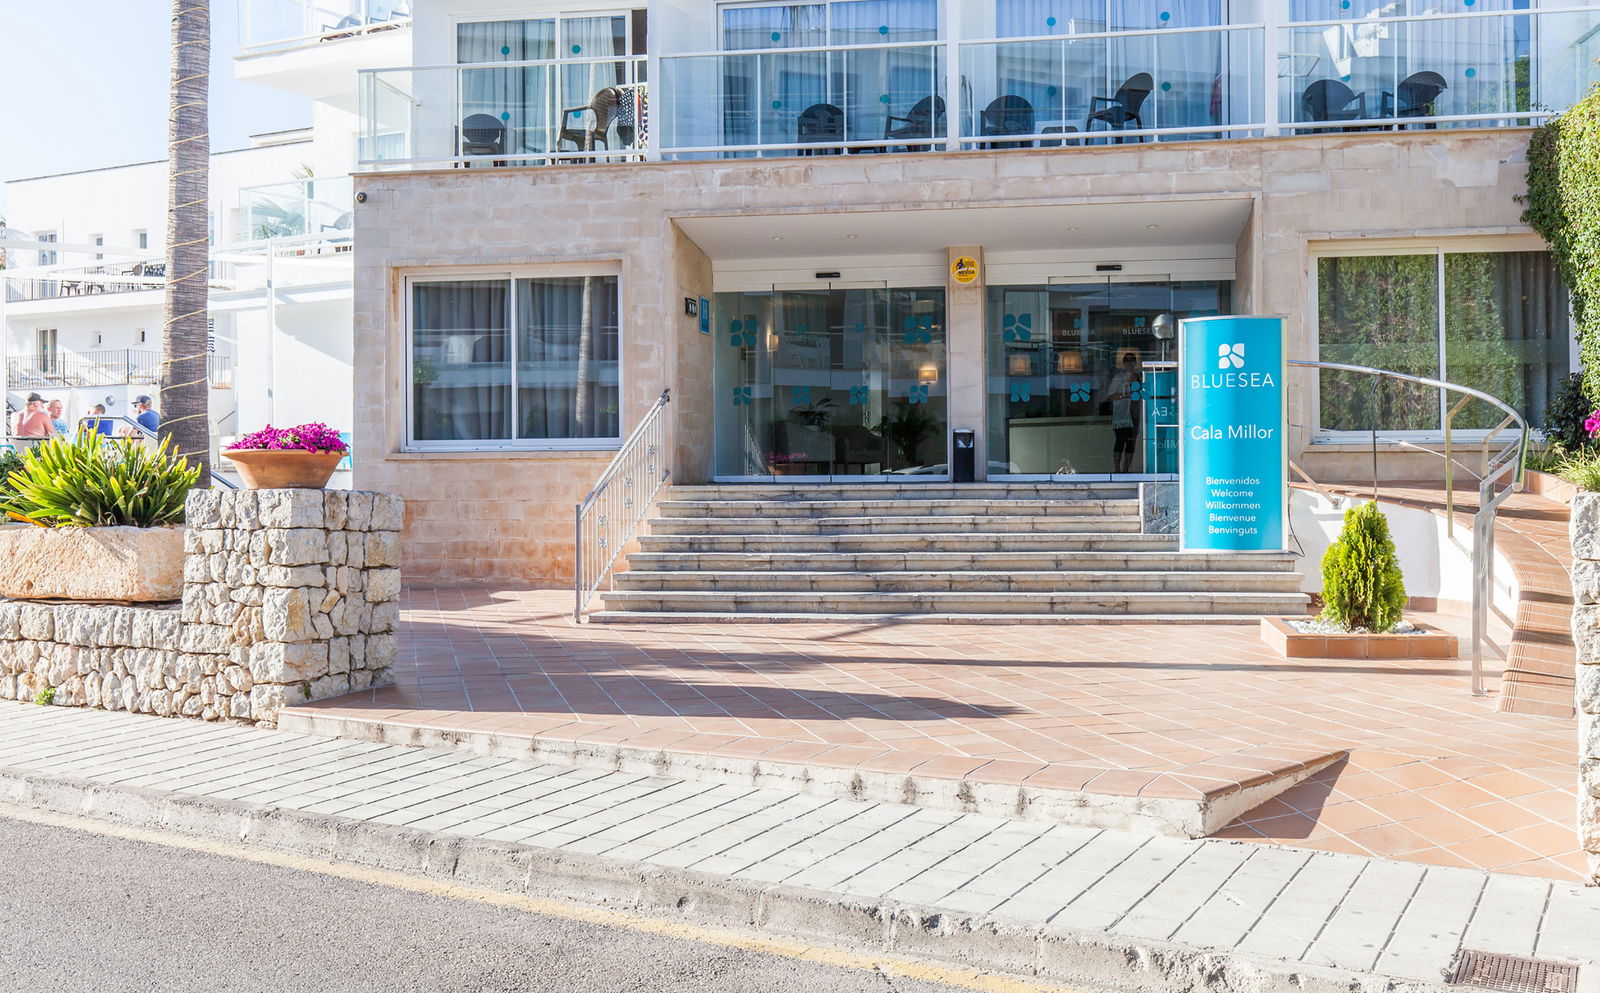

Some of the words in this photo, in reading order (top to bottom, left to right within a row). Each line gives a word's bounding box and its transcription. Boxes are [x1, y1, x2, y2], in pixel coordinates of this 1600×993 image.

[1122, 327, 1156, 335] BLUESE
[1191, 372, 1275, 389] BLUESEA
[1191, 424, 1223, 440] Cala
[1228, 424, 1274, 440] Millor
[1205, 476, 1261, 485] Bienvenidos
[1211, 488, 1254, 498] Welcome
[1205, 501, 1261, 510] Willkommen
[1209, 513, 1257, 522] Bienvenue
[1208, 526, 1258, 536] Benvinguts
